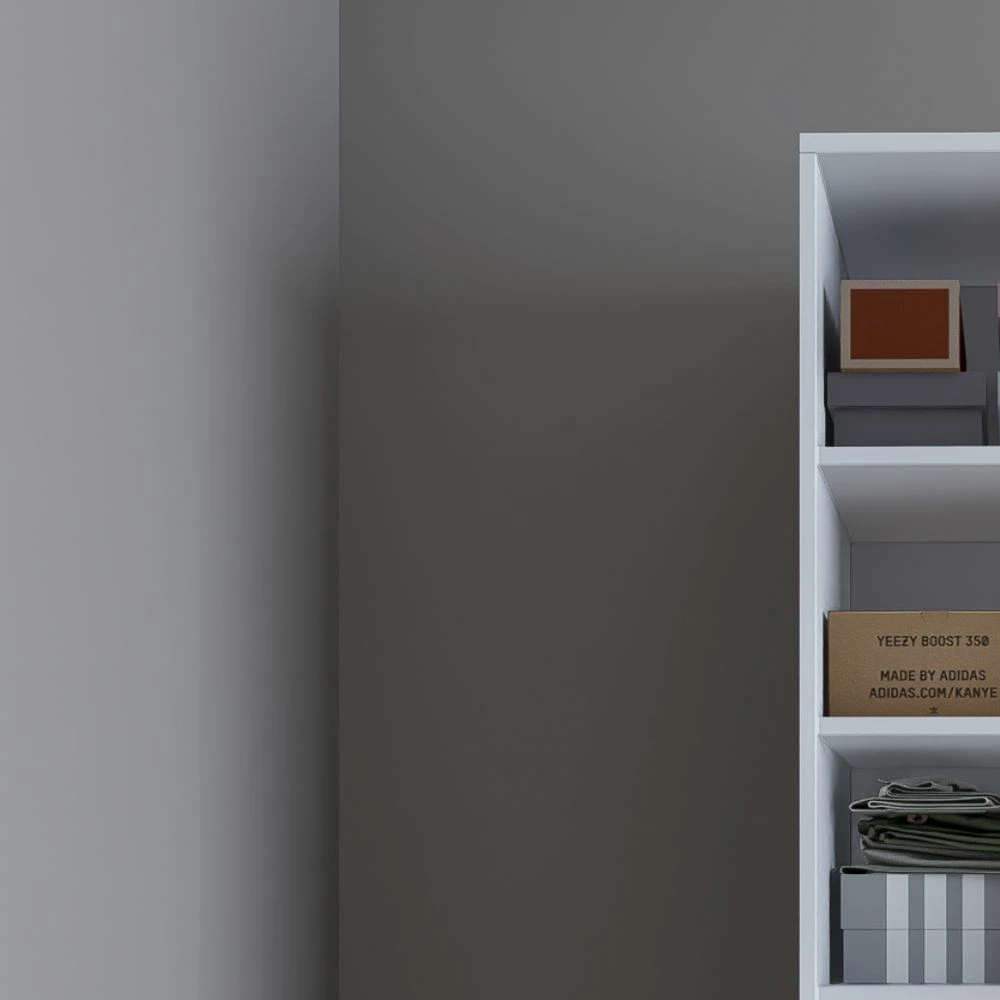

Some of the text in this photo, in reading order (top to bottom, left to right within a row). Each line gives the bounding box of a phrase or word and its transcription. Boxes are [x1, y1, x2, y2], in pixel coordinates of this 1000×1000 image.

[876, 635, 989, 647] YEEZY BOOST 350
[880, 669, 986, 681] MADE BY ADIDAS
[868, 687, 998, 698] ADIDAS.COM/KANYE
